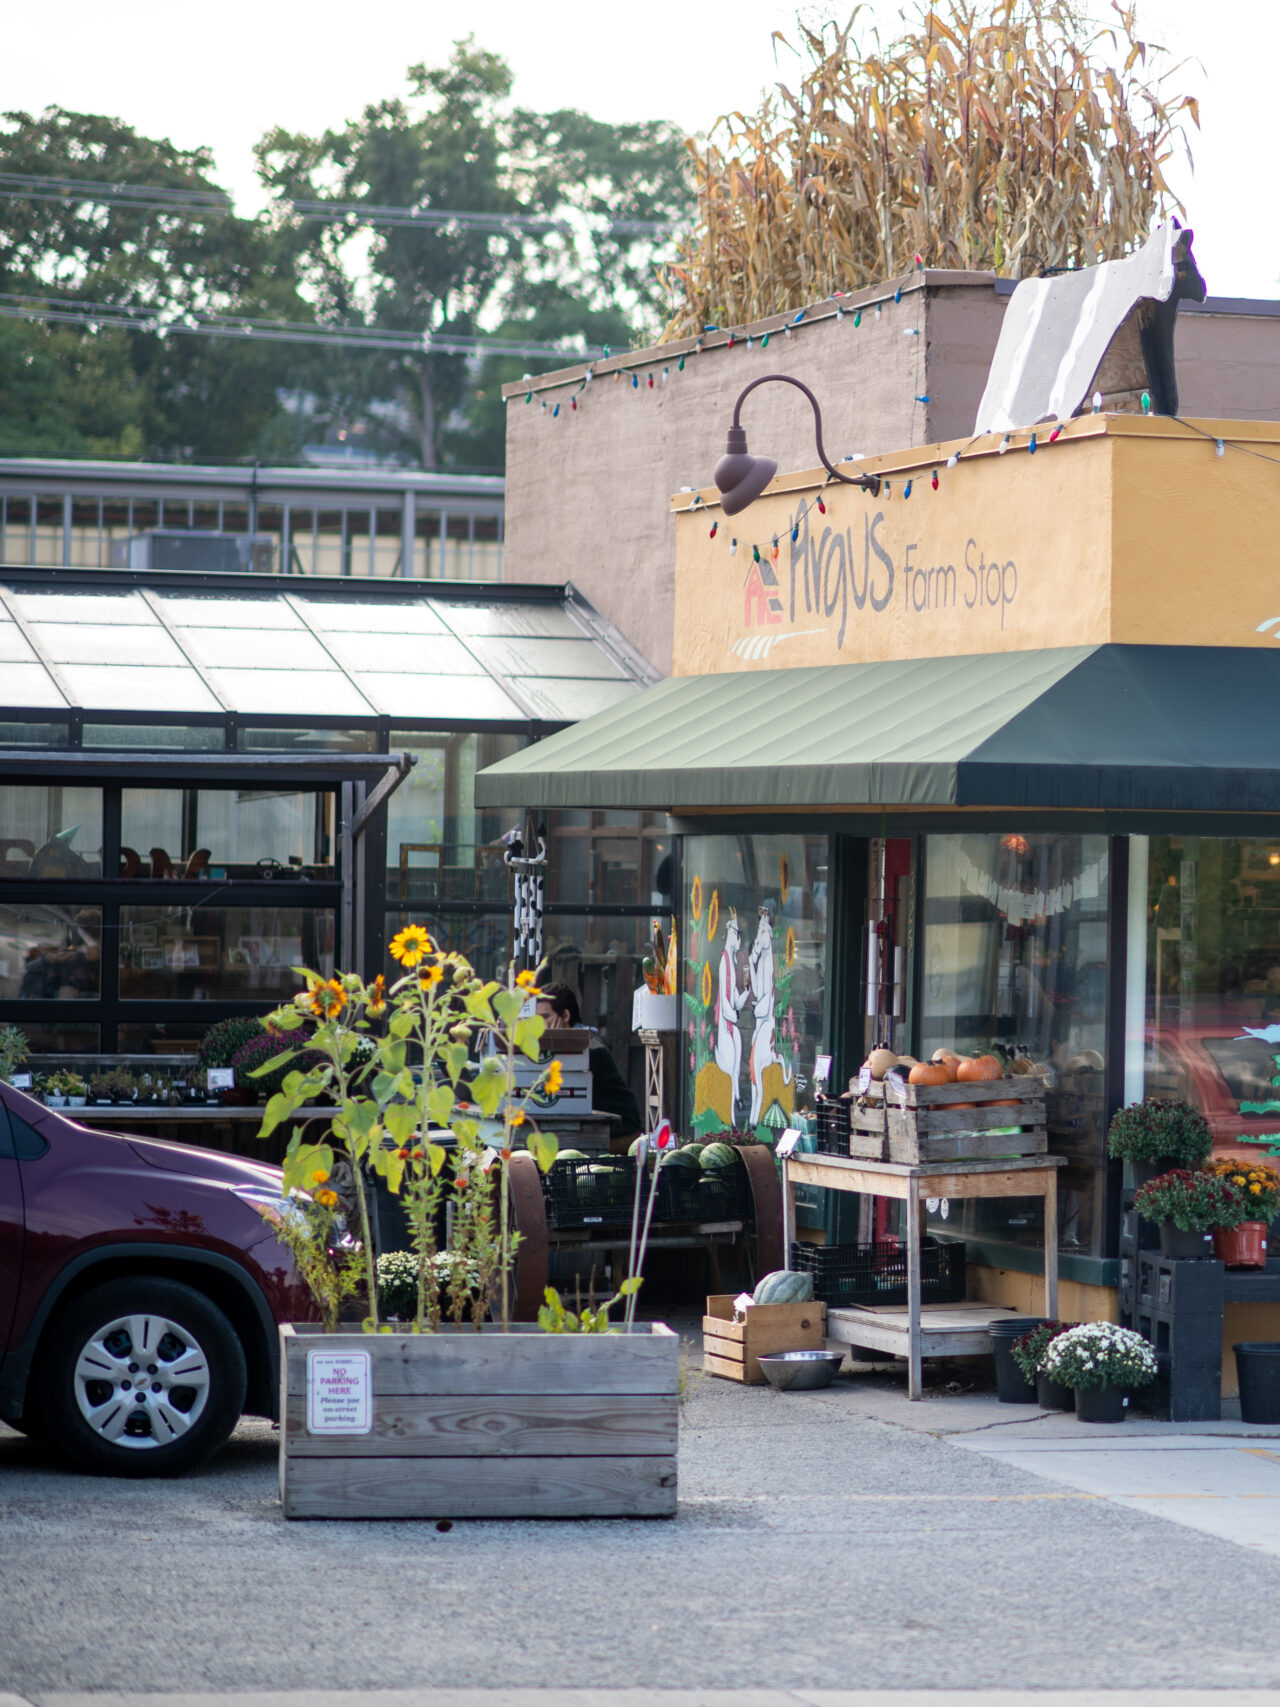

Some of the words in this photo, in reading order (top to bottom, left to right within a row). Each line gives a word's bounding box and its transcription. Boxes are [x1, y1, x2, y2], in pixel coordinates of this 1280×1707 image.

[788, 496, 895, 650] Argus
[903, 543, 957, 612] Farm
[963, 537, 1018, 631] Stop
[320, 1377, 359, 1385] PARKING
[328, 1387, 351, 1395] HERE
